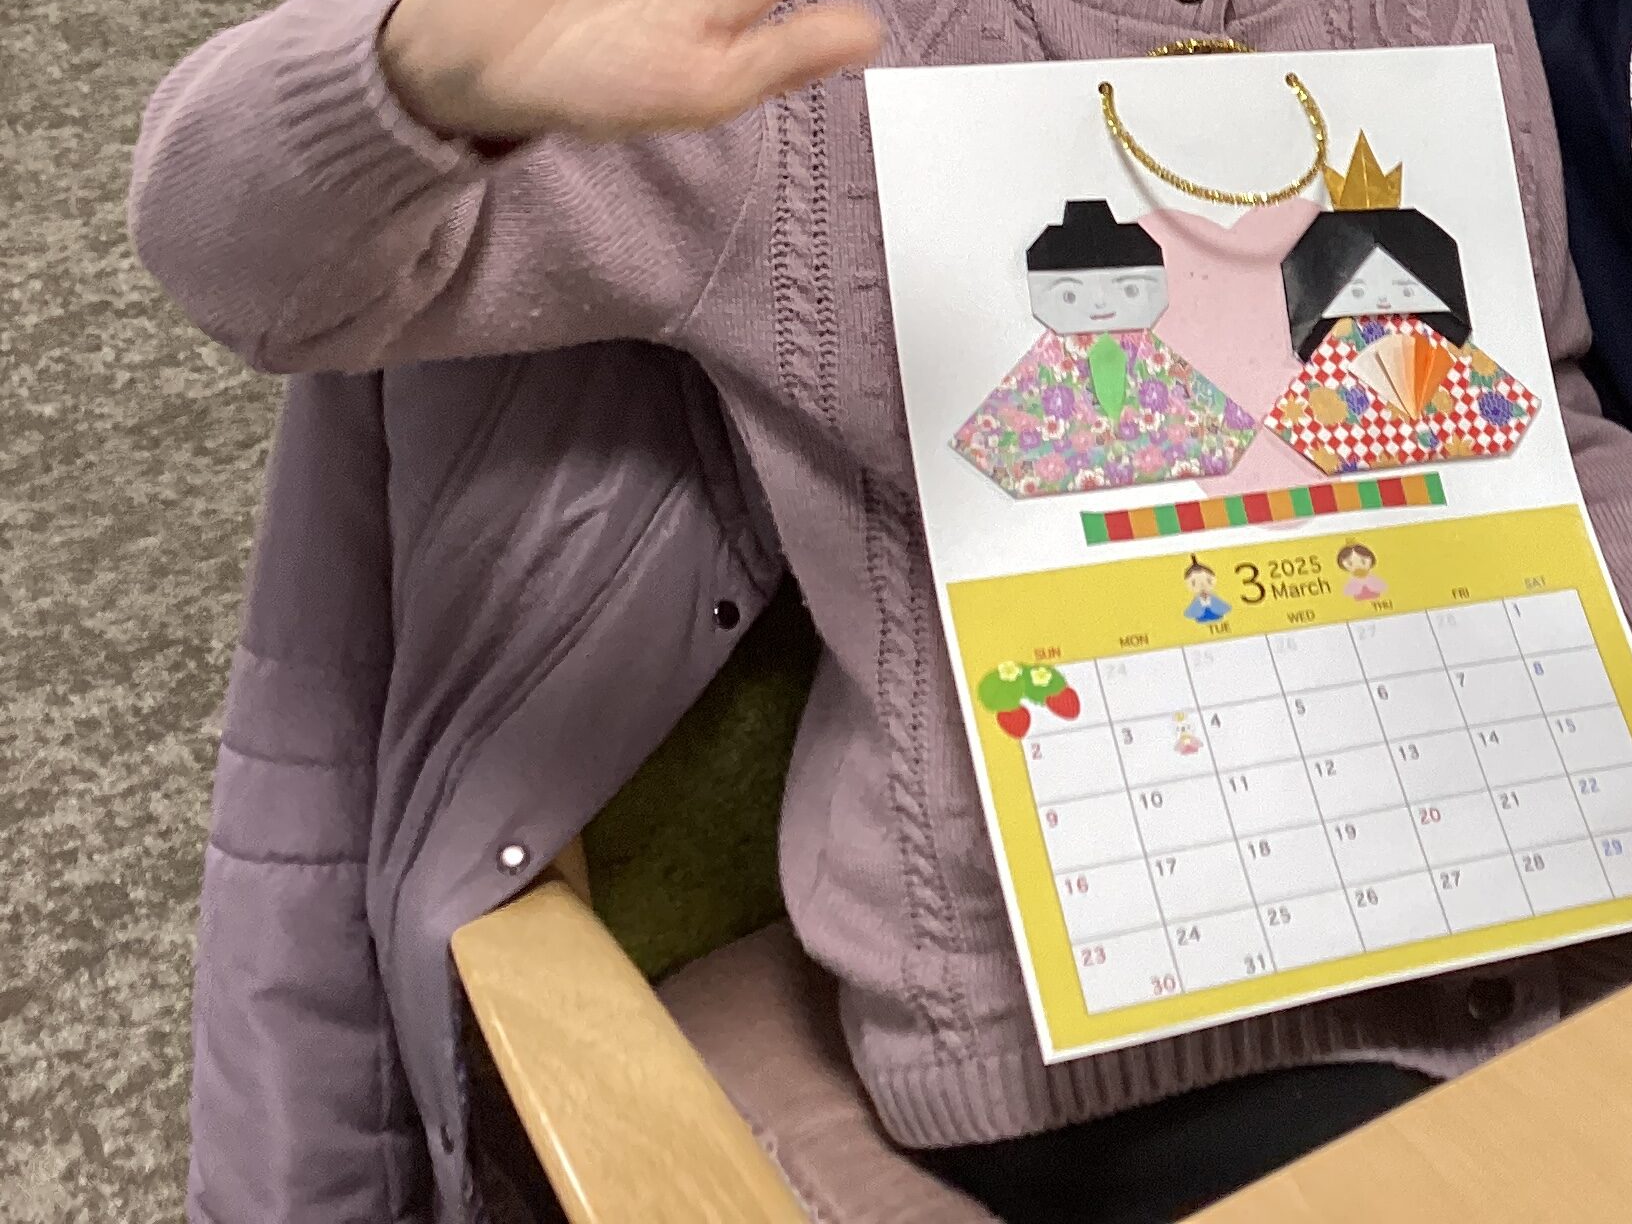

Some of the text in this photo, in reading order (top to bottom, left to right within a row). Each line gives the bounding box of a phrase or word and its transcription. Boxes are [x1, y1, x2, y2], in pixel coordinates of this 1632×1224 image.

[1235, 562, 1267, 604] 3
[1268, 555, 1322, 579] 2025
[1270, 575, 1332, 601] March
[1033, 576, 1546, 661] SUN MON TUE WED THU FRI SAT
[1358, 624, 1377, 640] 27
[1513, 603, 1521, 618] 1
[1031, 661, 1545, 760] 2 3 4 5 6 7 8
[1046, 718, 1577, 828] 9 10 11 12 13 14 15
[1065, 777, 1600, 895] 16 17 18 19 20 21 22
[1082, 839, 1623, 966] 23 24 25 26 27 28 29
[1151, 953, 1267, 994] 30 31
